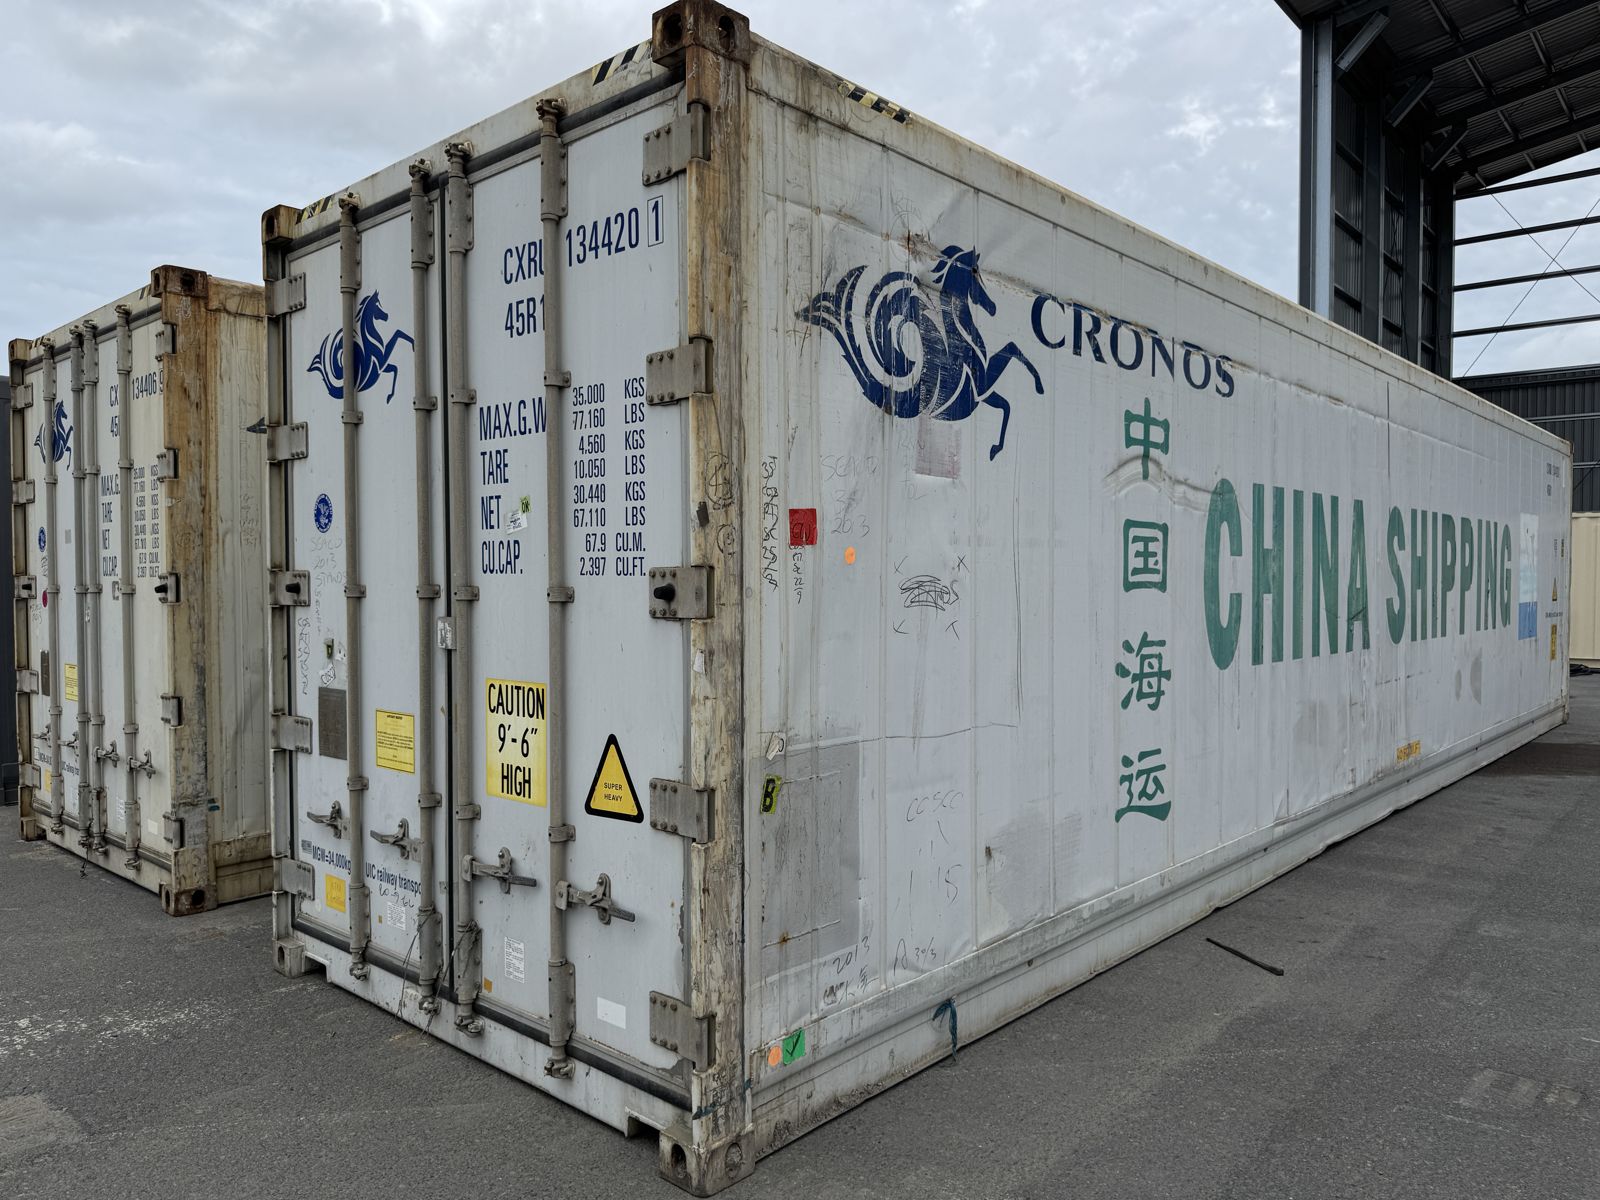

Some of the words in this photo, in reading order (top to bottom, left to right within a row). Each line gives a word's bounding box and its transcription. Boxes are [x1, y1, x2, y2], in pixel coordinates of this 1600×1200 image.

[565, 207, 640, 267] 134420
[1030, 289, 1236, 398] CRONOS
[110, 384, 119, 407] CX
[131, 371, 157, 400] 134406
[624, 376, 646, 399] KGS
[624, 402, 646, 424] LBS
[110, 415, 120, 438] 45
[624, 429, 646, 451] KGS
[480, 449, 509, 485] TARE
[625, 454, 646, 475] LBS
[101, 473, 120, 496] MAX.G.
[625, 481, 646, 502] KGS
[481, 495, 501, 530] NET
[625, 506, 646, 526] LBS
[585, 532, 607, 552] 67.9
[615, 532, 646, 552] CU.M.
[481, 539, 524, 575] CU.CAP.
[615, 556, 646, 577] CU.FT.
[1203, 478, 1371, 670] CHINA
[1386, 506, 1512, 645] SHIPPING
[1115, 397, 1172, 824] 中国海运
[488, 682, 545, 720] CAUTION
[501, 762, 532, 799] HIGH
[603, 782, 623, 792] SUPER
[603, 793, 623, 803] HEAVY
[366, 861, 376, 879] UIC
[377, 867, 397, 891] railway
[398, 873, 422, 897] transpo
